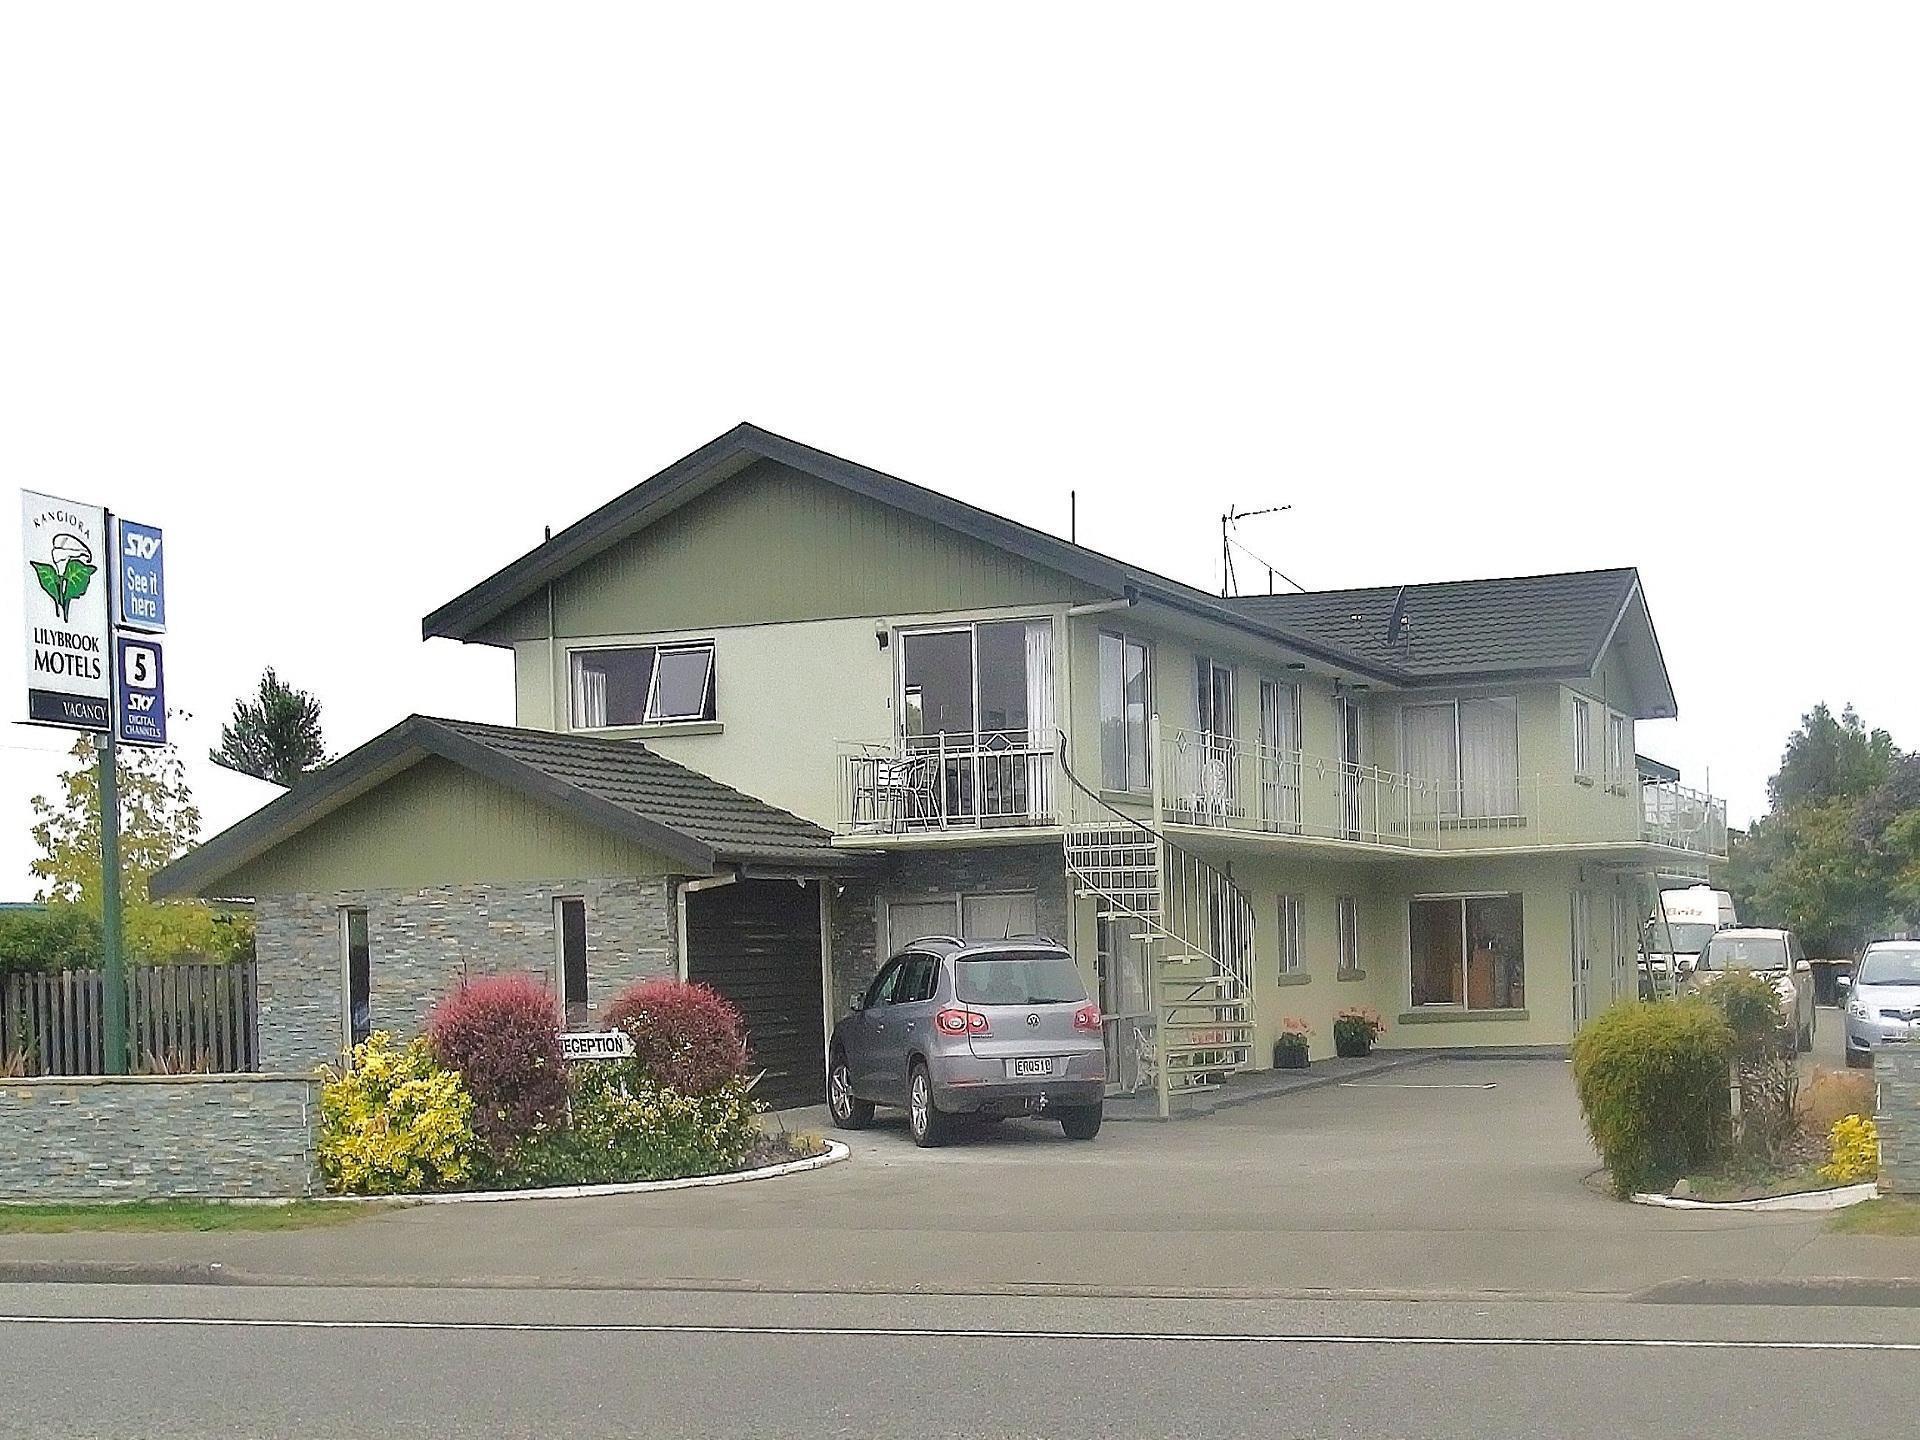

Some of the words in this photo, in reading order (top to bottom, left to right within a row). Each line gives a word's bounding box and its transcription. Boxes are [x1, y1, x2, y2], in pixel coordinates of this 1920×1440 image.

[33, 510, 89, 539] RANGIORA
[125, 533, 161, 559] SKY
[127, 566, 148, 593] See
[150, 570, 158, 596] it
[132, 592, 156, 618] here
[34, 627, 100, 652] LILYBROOK
[34, 649, 101, 679] MOTELS
[134, 653, 146, 682] 5
[62, 701, 106, 721] VACANCY
[127, 693, 156, 712] SKY
[125, 724, 161, 738] CHANNELS
[128, 714, 156, 727] DIGITAL
